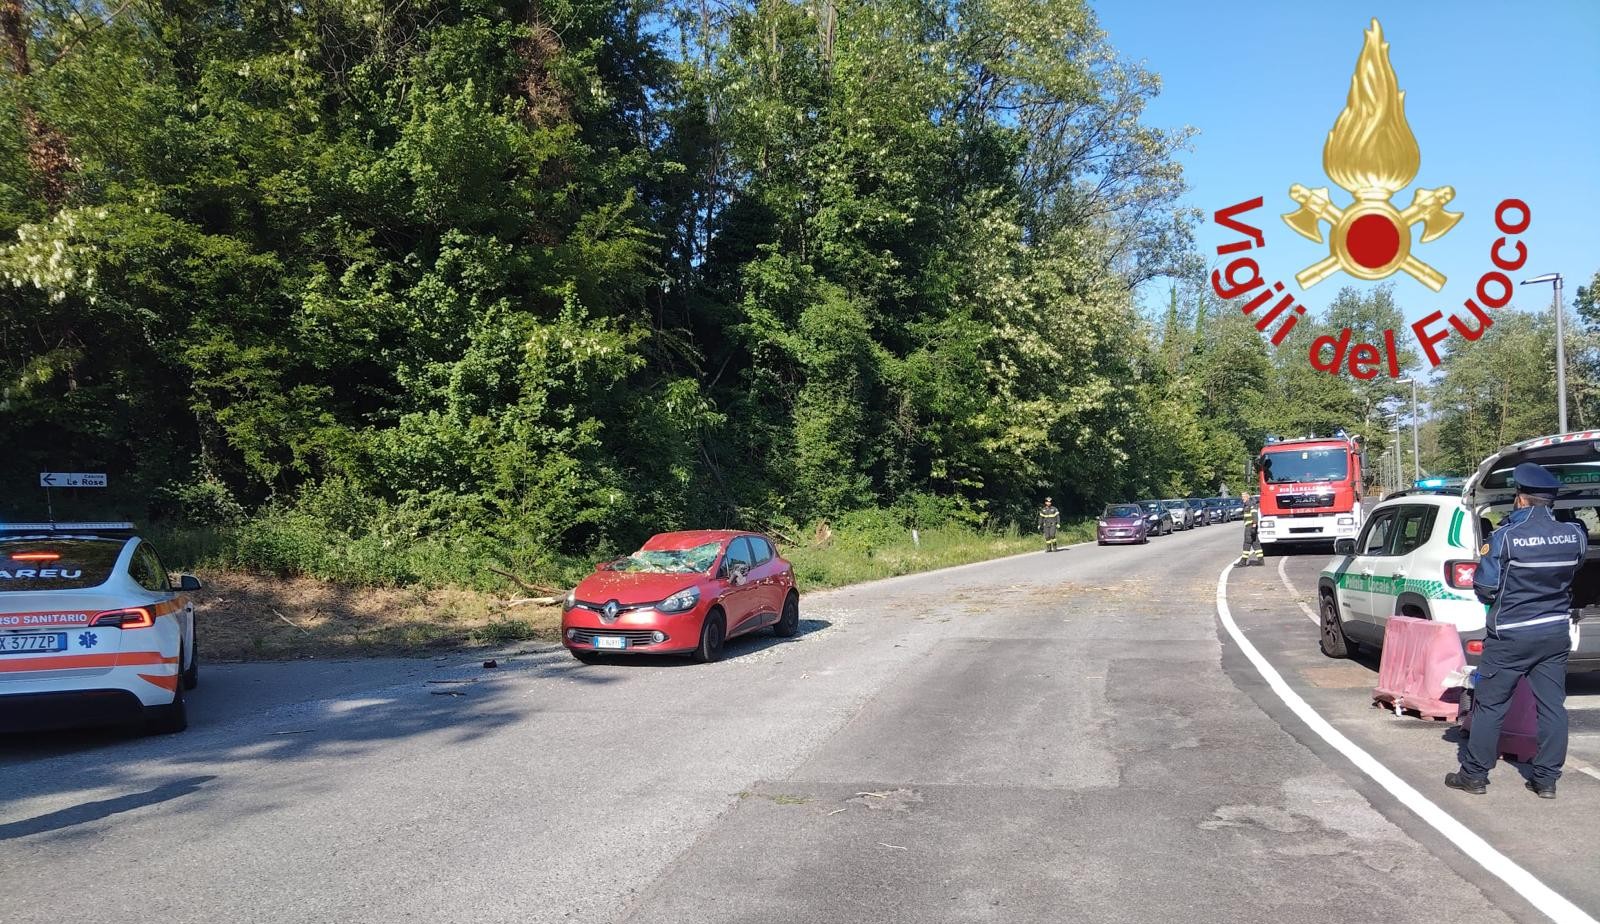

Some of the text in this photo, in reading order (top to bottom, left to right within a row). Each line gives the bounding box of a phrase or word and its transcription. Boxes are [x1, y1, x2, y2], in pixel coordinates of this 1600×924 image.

[1513, 534, 1577, 547] POLIZIA LOCALE
[0, 569, 82, 578] AREU
[23, 613, 88, 624] SANITARIO
[12, 635, 55, 649] 377ZP
